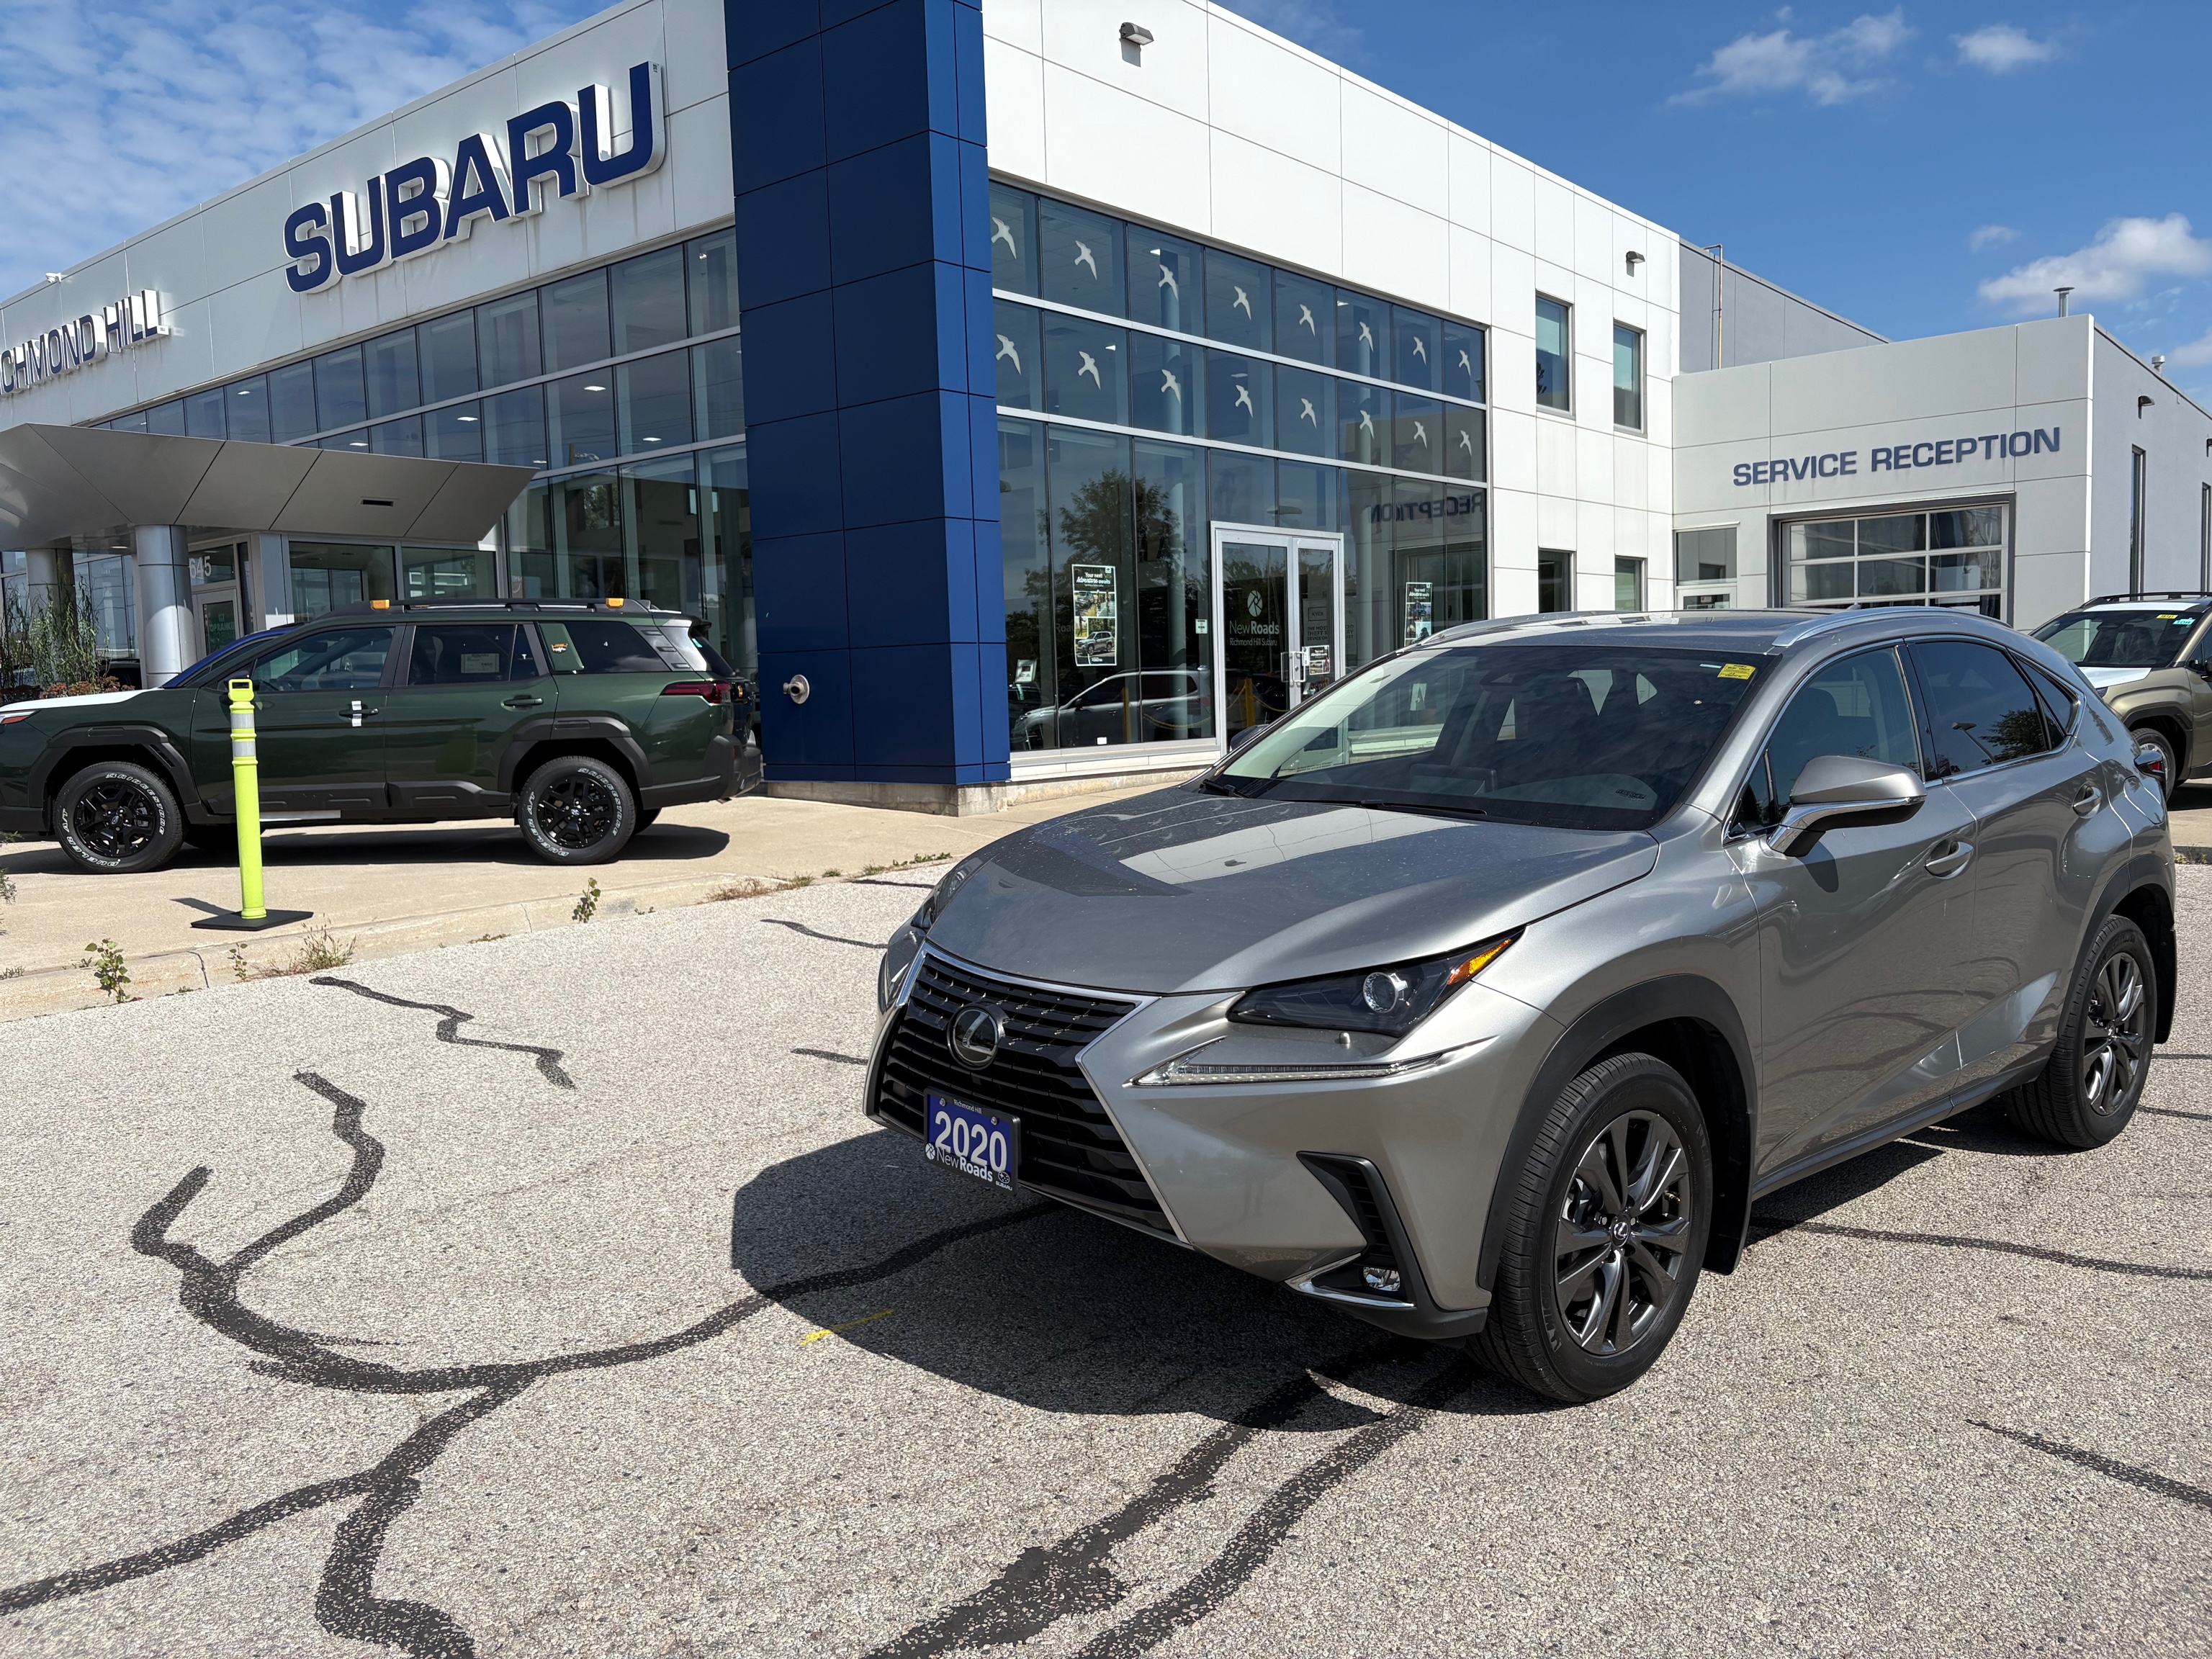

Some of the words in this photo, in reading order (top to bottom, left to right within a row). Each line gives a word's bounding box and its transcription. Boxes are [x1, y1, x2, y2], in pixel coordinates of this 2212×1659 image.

[284, 61, 659, 292] SUBARU
[0, 315, 101, 395] CHMOND
[103, 289, 160, 353] HILL
[1732, 451, 1857, 487] SERVICE
[1871, 426, 2061, 472] RECEPTION
[189, 555, 212, 579] 645
[1228, 620, 1280, 634] NewRoads
[1229, 637, 1253, 646] Richmond
[1262, 637, 1277, 646] Subaru
[953, 1099, 974, 1112] Richmond
[935, 1110, 1007, 1172] 2020
[937, 1147, 994, 1182] NewRoads
